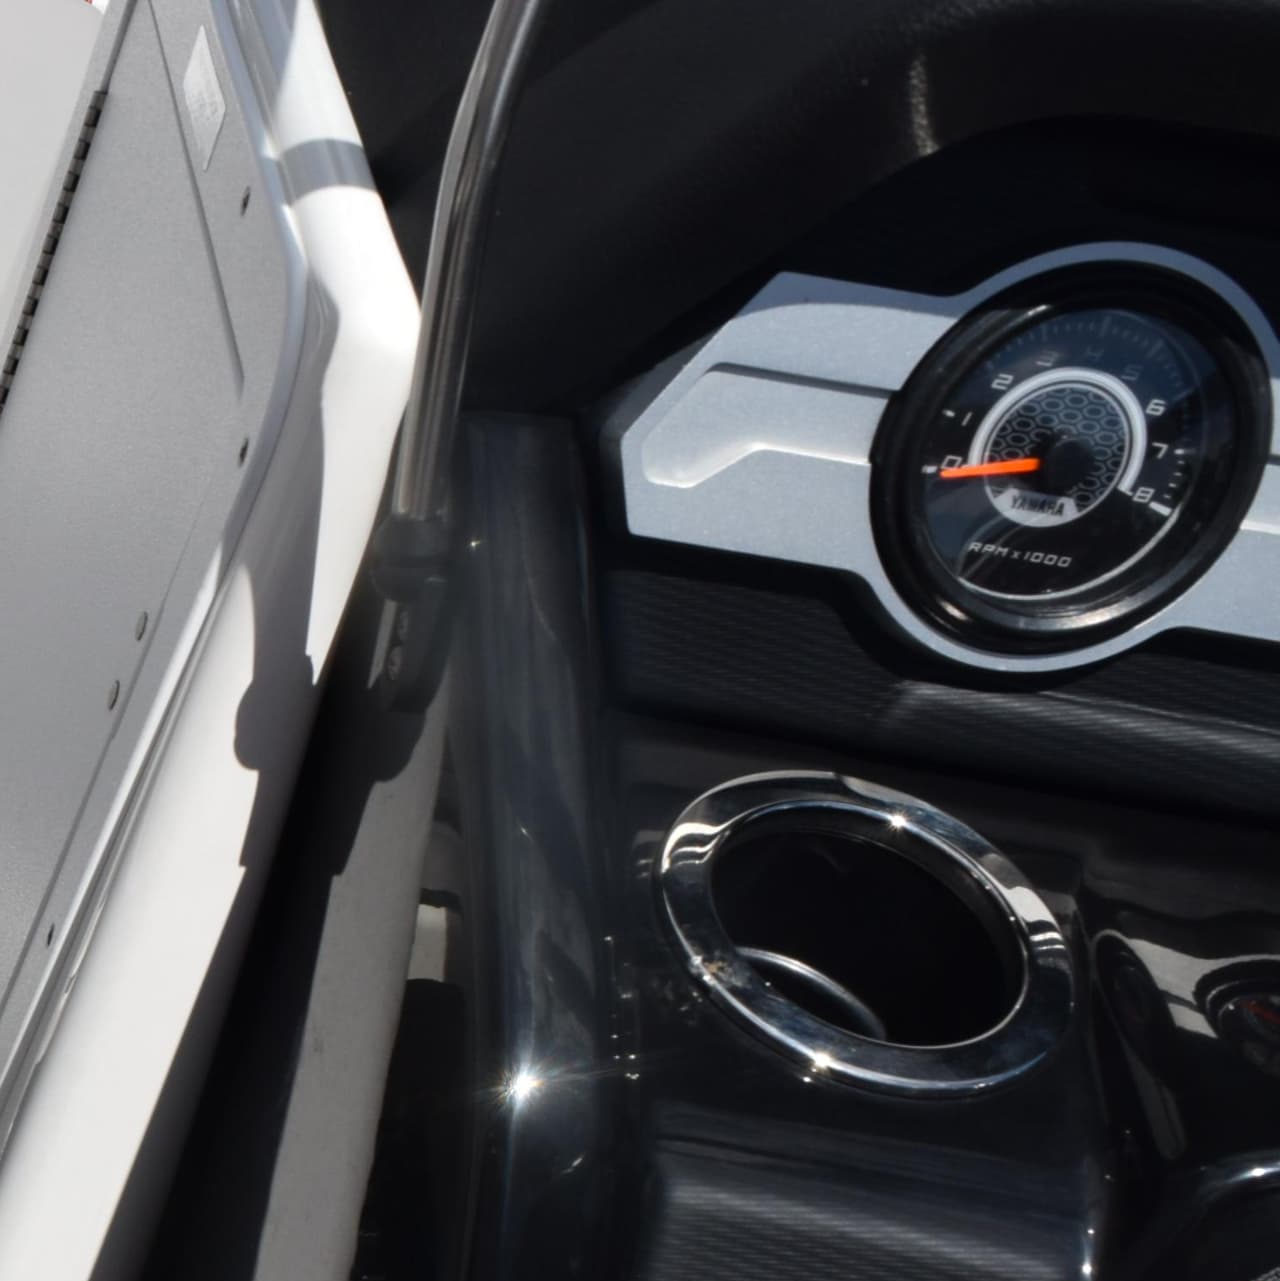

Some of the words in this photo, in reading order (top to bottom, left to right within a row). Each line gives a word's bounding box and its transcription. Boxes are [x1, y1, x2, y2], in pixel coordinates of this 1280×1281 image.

[1035, 350, 1059, 368] 3
[991, 374, 1014, 390] 2
[1146, 399, 1166, 416] 6
[961, 411, 973, 426] 1
[1152, 442, 1168, 459] 7
[941, 455, 962, 472] 0
[1132, 487, 1155, 504] 8
[1010, 495, 1065, 517] YAMAHA
[967, 541, 1008, 559] RPM
[1023, 551, 1073, 568] 1000
